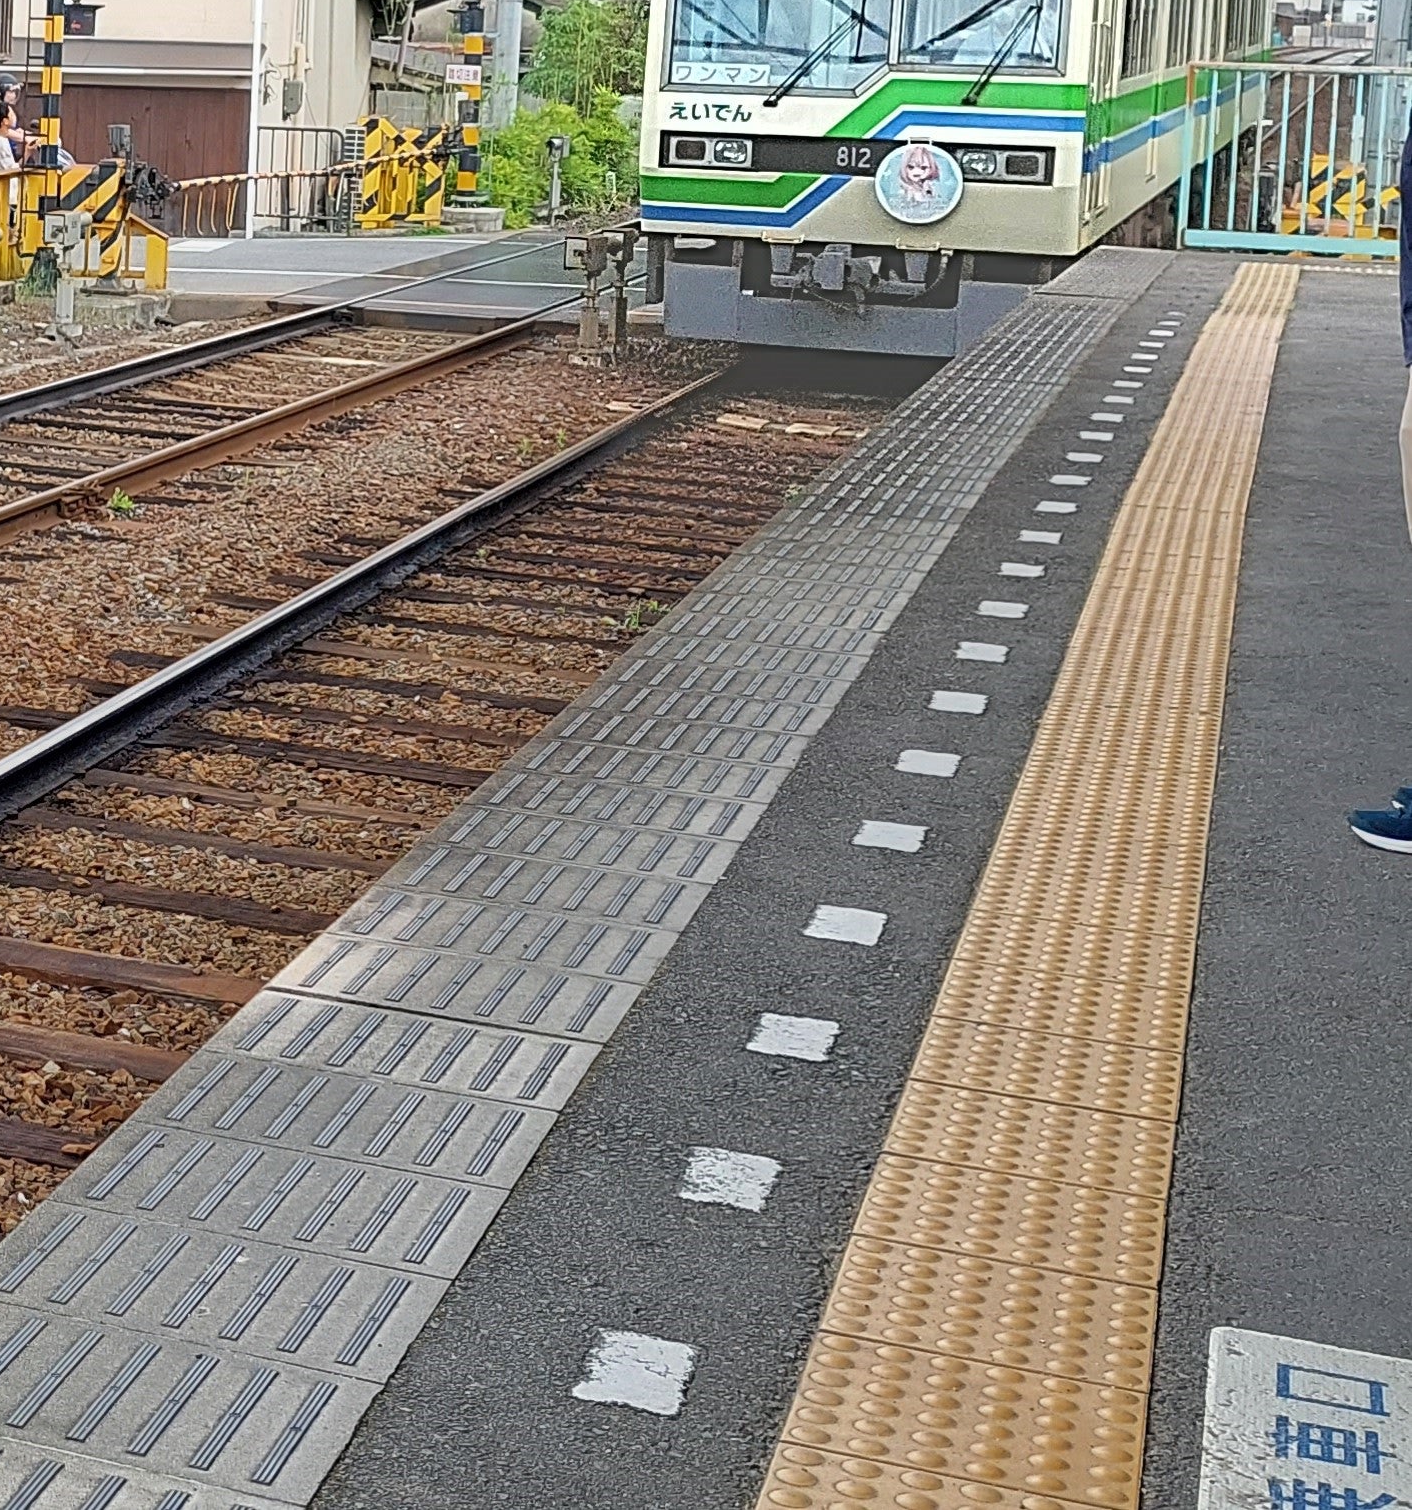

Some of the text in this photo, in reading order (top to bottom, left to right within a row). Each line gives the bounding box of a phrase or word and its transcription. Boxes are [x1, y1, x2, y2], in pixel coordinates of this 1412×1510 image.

[675, 64, 768, 85] ワンマン
[669, 101, 753, 123] えいでん
[836, 146, 872, 169] 812
